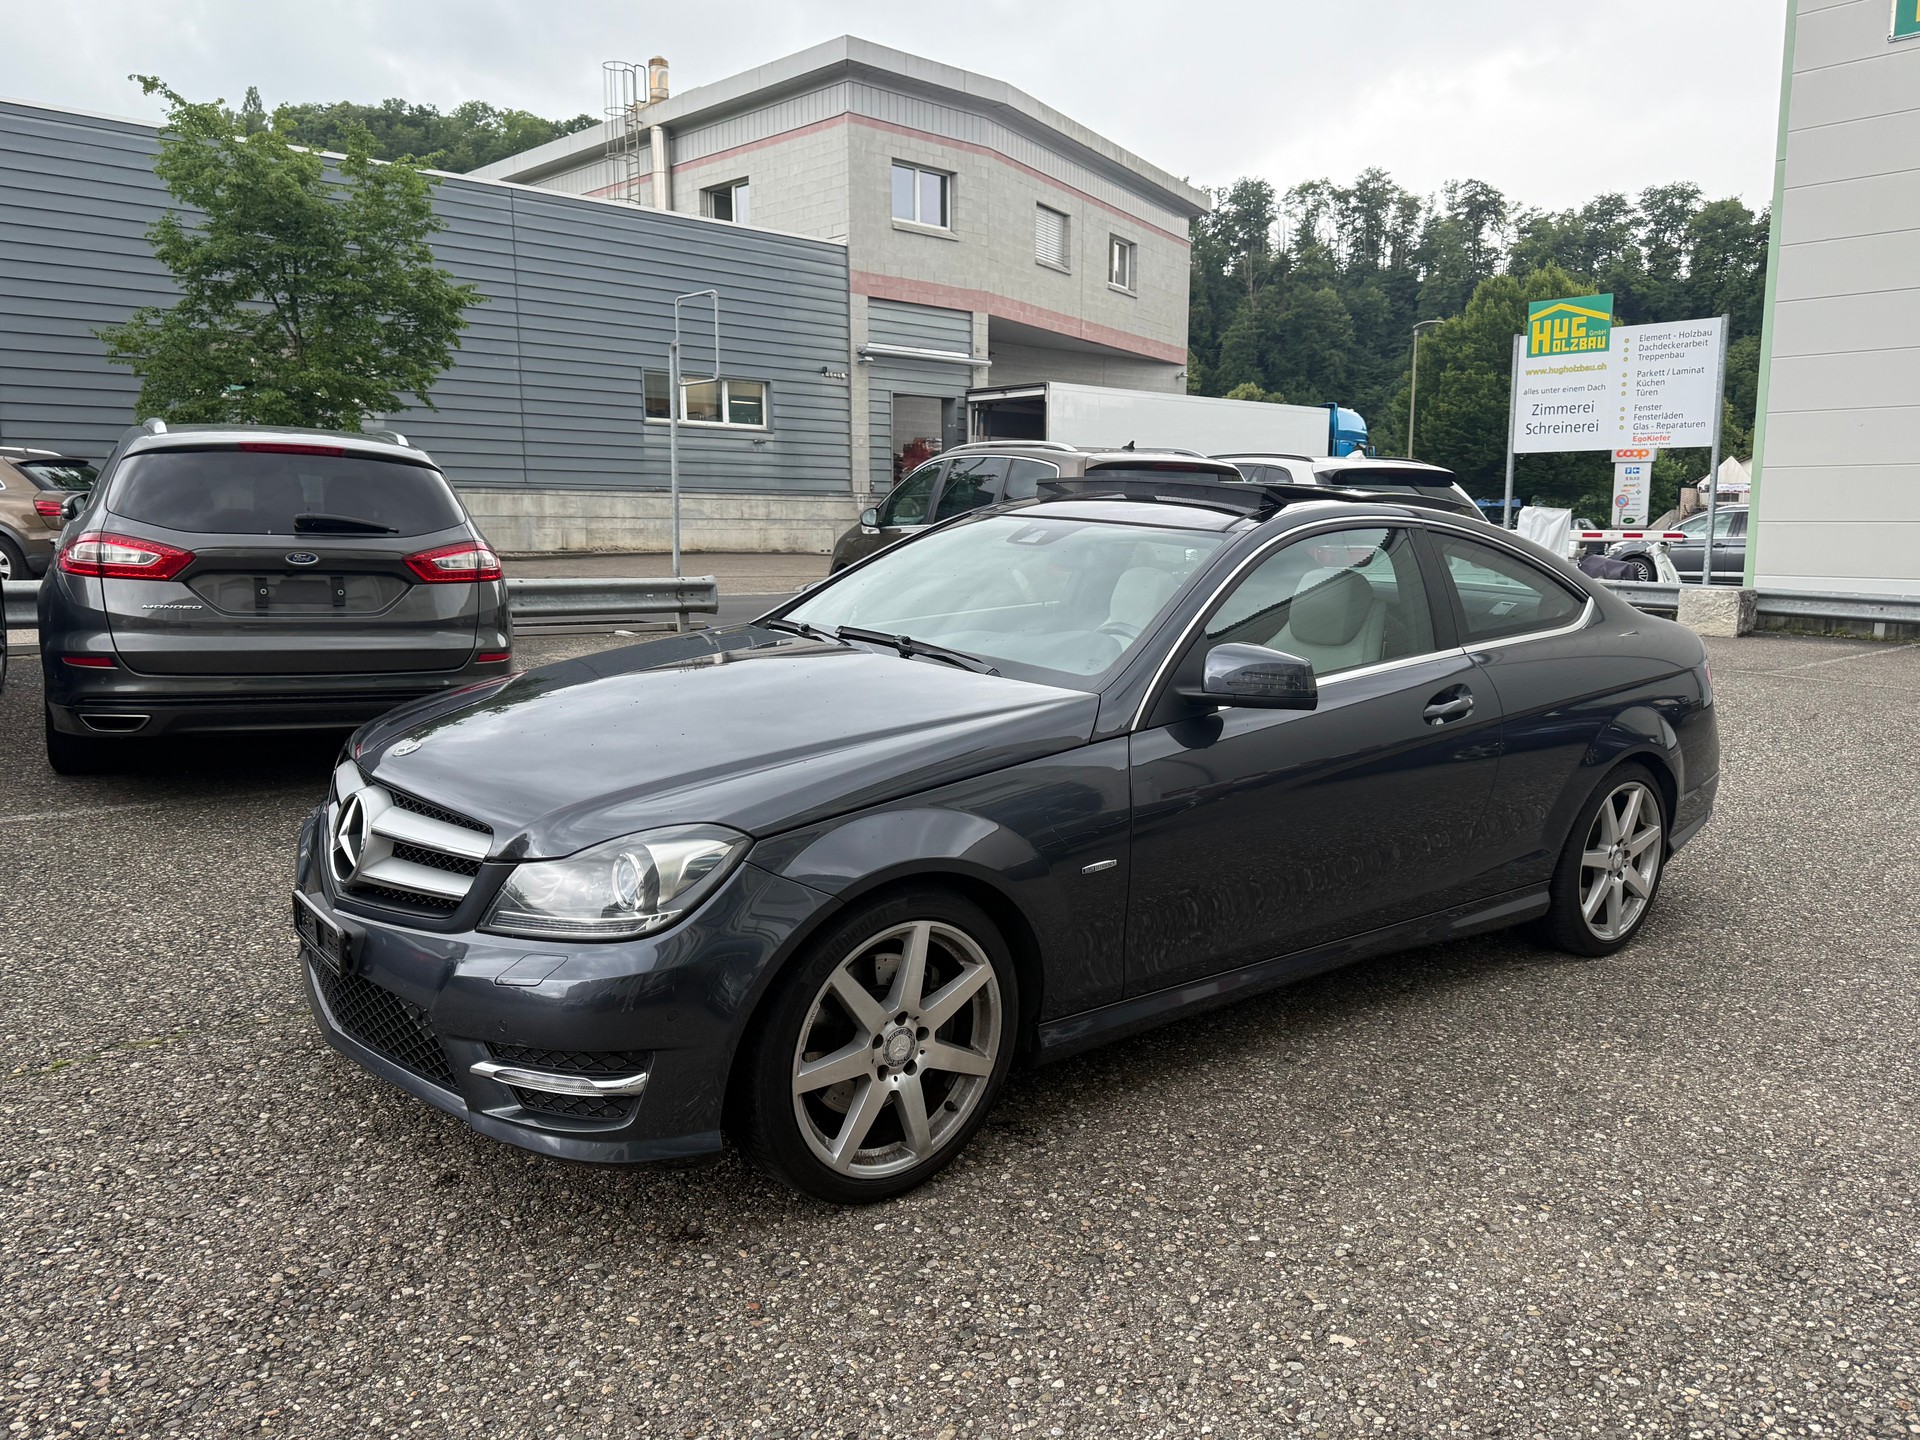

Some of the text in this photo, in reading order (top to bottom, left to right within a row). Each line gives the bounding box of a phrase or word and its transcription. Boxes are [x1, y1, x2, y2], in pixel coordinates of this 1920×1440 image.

[1531, 316, 1587, 354] HUG
[1640, 333, 1671, 342] Element
[1679, 330, 1713, 339] Holzbau
[1638, 339, 1708, 352] Dachdeckerarbeit
[1638, 352, 1685, 362] Treppenbau
[1525, 363, 1607, 376] www.hugholzbau.ch
[1637, 369, 1665, 378] Parkett
[1672, 366, 1705, 376] Laminat
[1636, 379, 1665, 387] Küchen
[1562, 385, 1585, 393] einem
[1636, 389, 1658, 397] Türen
[1531, 400, 1595, 416] Zimmerei
[1634, 404, 1662, 412] Fenster
[1633, 412, 1684, 421] Fensterläden
[1525, 419, 1599, 435] Schreinerei
[1632, 423, 1649, 431] Glas
[1656, 421, 1706, 430] Reparaturen
[1632, 435, 1671, 443] EgoKiefer
[1616, 449, 1649, 459] coop
